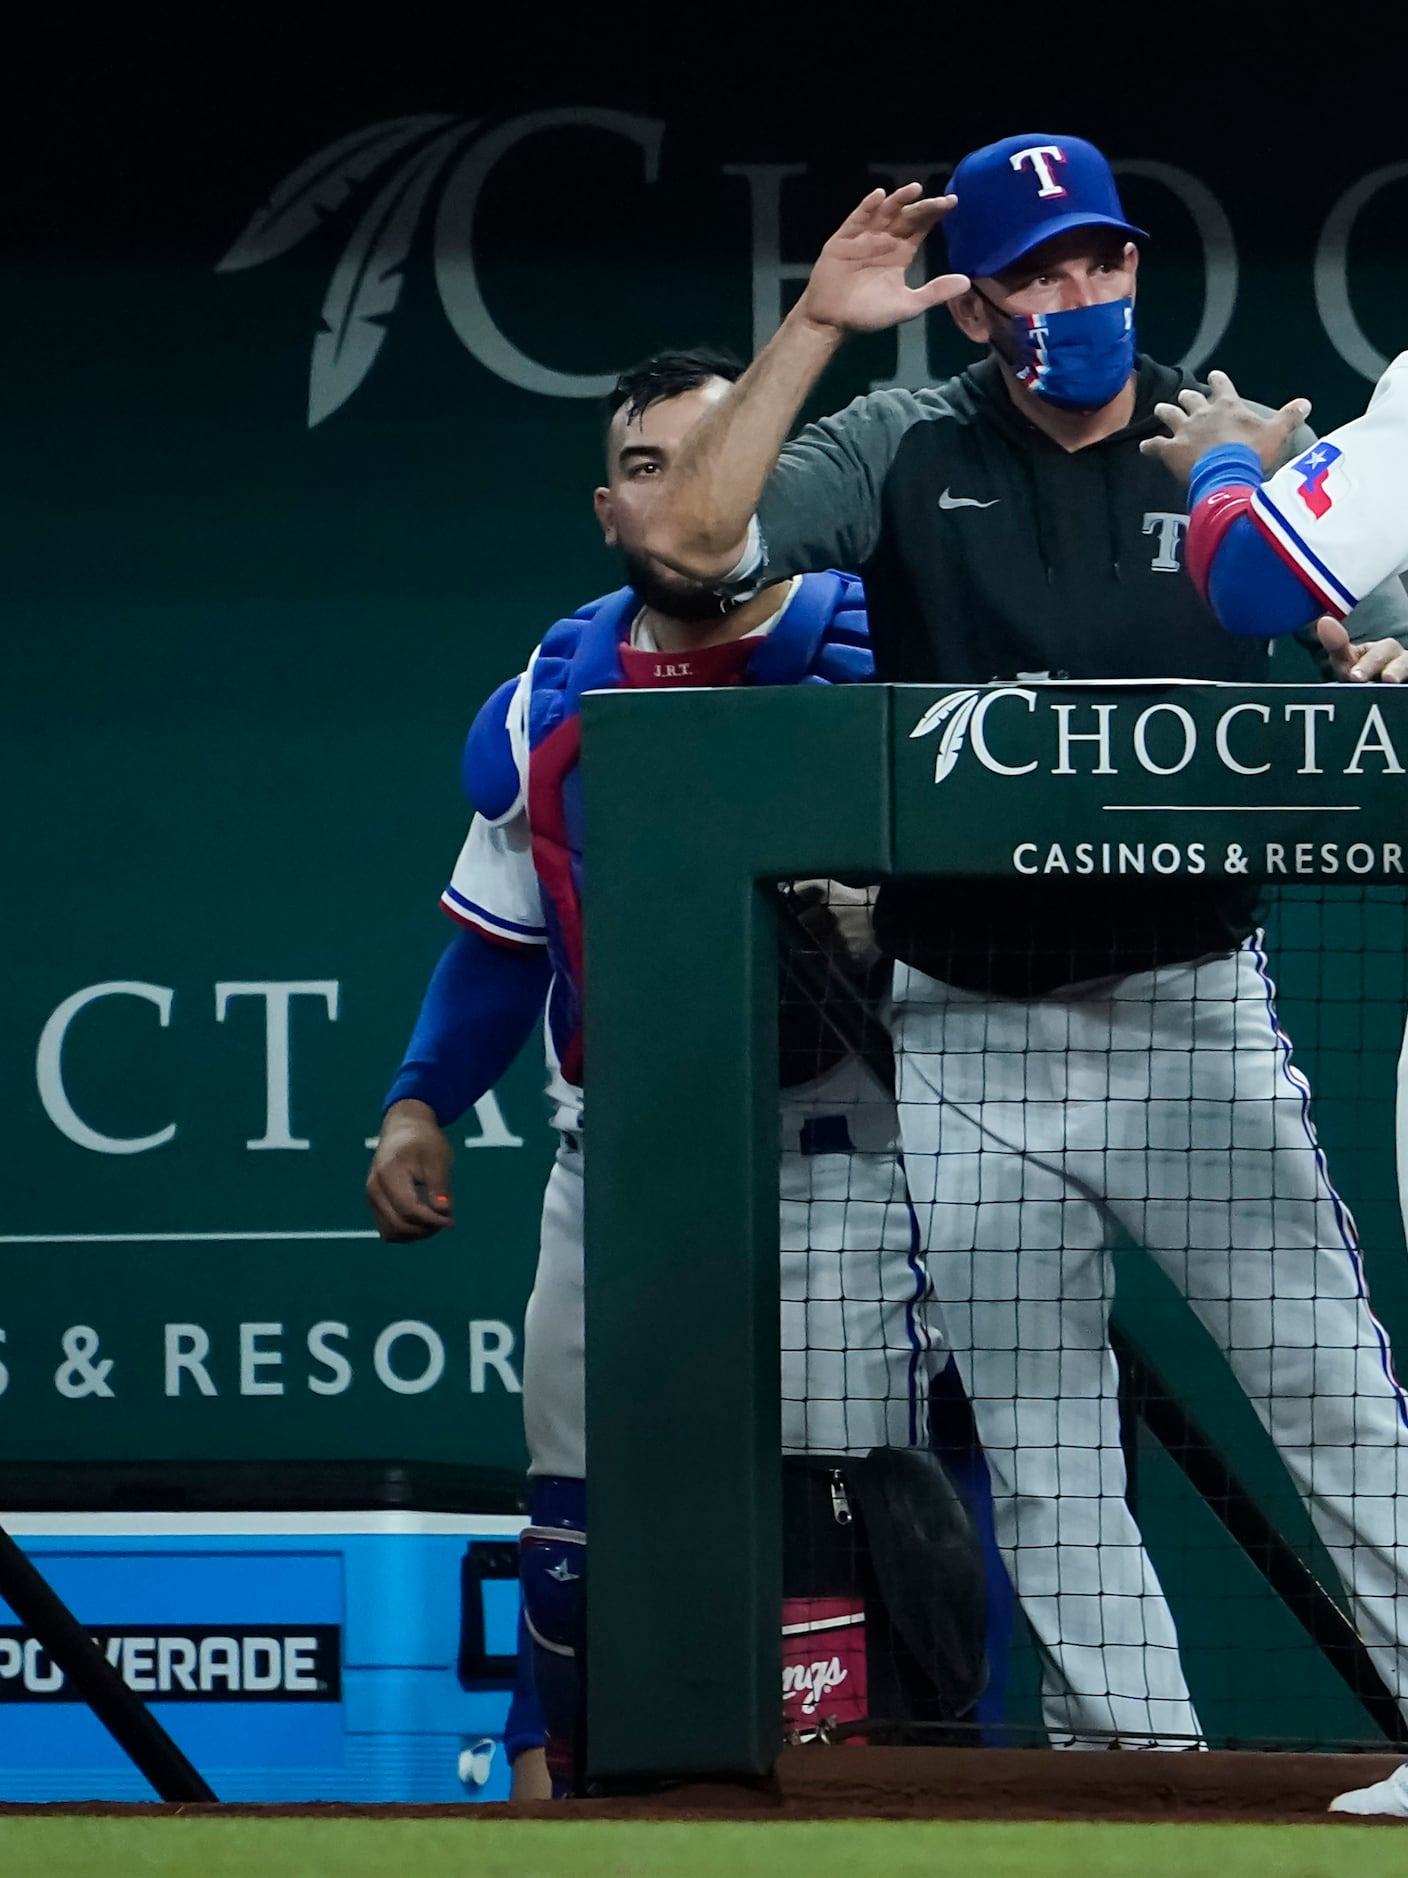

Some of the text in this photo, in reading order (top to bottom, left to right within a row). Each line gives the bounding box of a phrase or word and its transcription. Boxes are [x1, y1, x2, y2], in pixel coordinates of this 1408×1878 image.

[1009, 145, 1068, 199] T
[1142, 512, 1191, 572] T
[653, 663, 693, 678] J.R.T.
[1013, 842, 1206, 874] CASINOS
[1223, 843, 1249, 874] &
[54, 1325, 116, 1399] &
[164, 1319, 524, 1397] RESOR
[0, 1636, 319, 1692] POERADE
